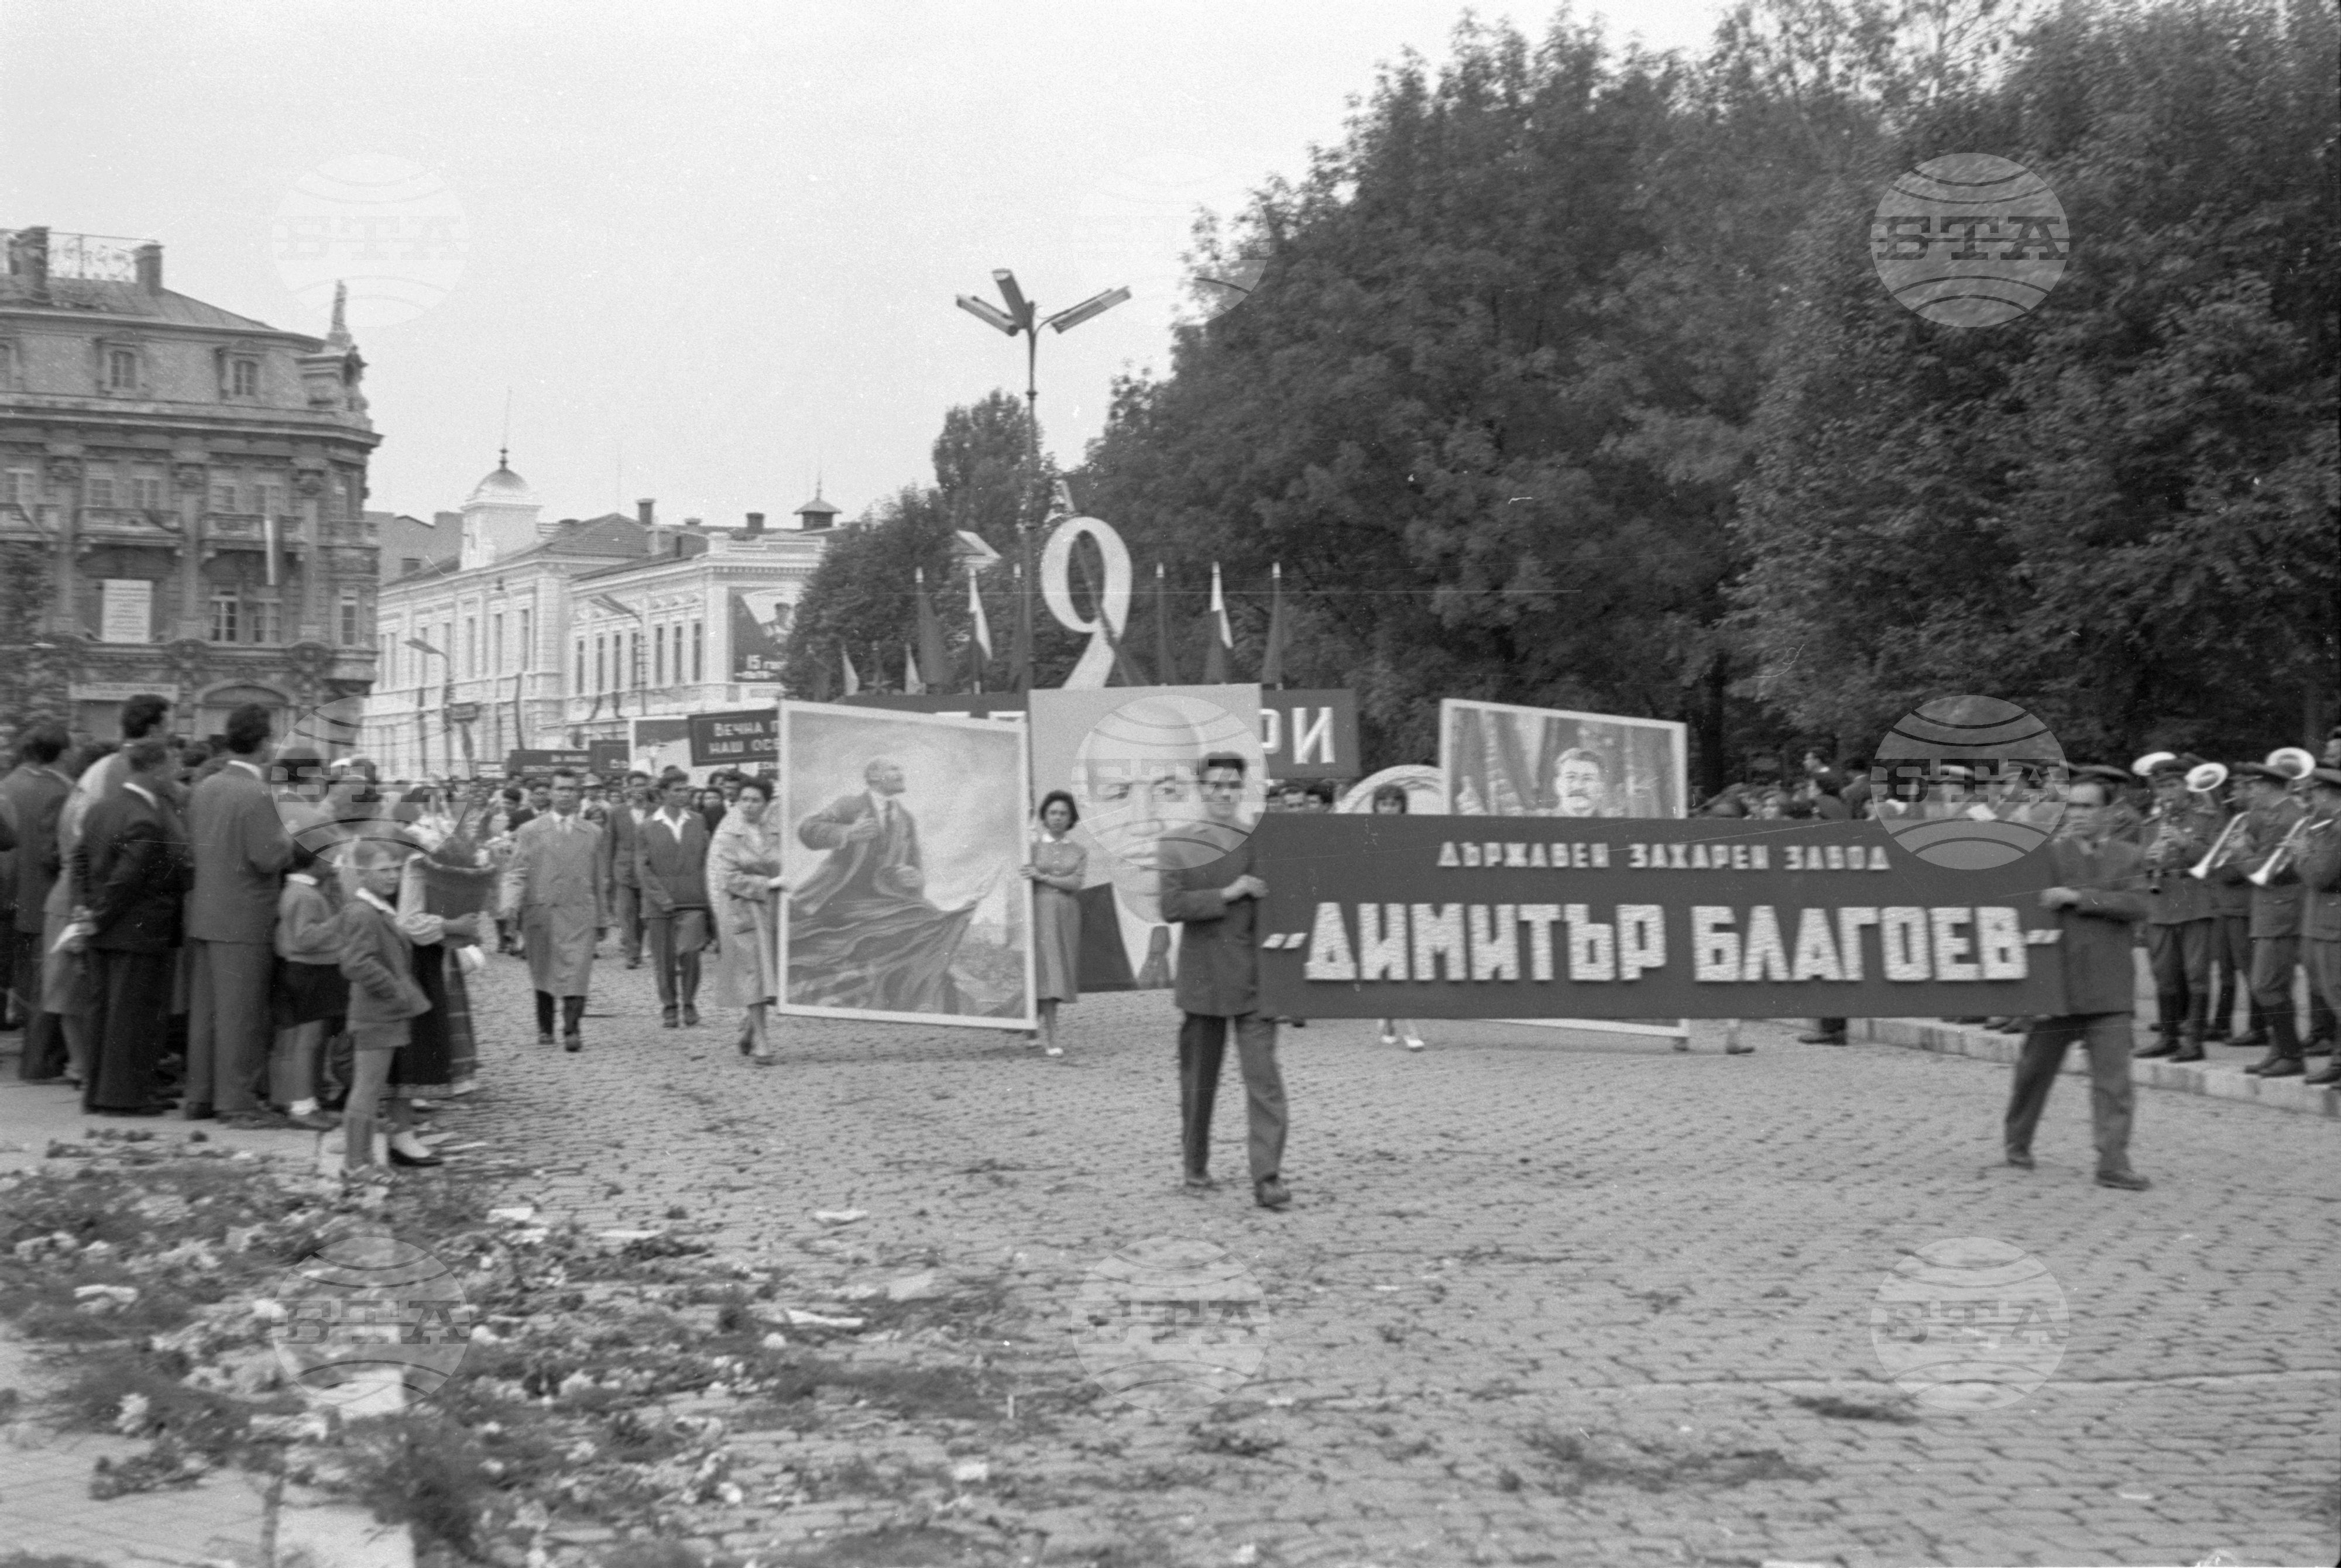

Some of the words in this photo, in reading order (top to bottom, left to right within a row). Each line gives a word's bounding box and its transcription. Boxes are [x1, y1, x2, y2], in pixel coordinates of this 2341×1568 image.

[1041, 517, 1132, 689] 9
[714, 721, 764, 737] ВЕЧНА
[708, 740, 744, 755] НАШ
[1437, 842, 1609, 867] ДЪРЖАВЕН
[1628, 843, 1769, 869] ЗАХАРЕН
[1783, 845, 1891, 870] ЗАВОД
